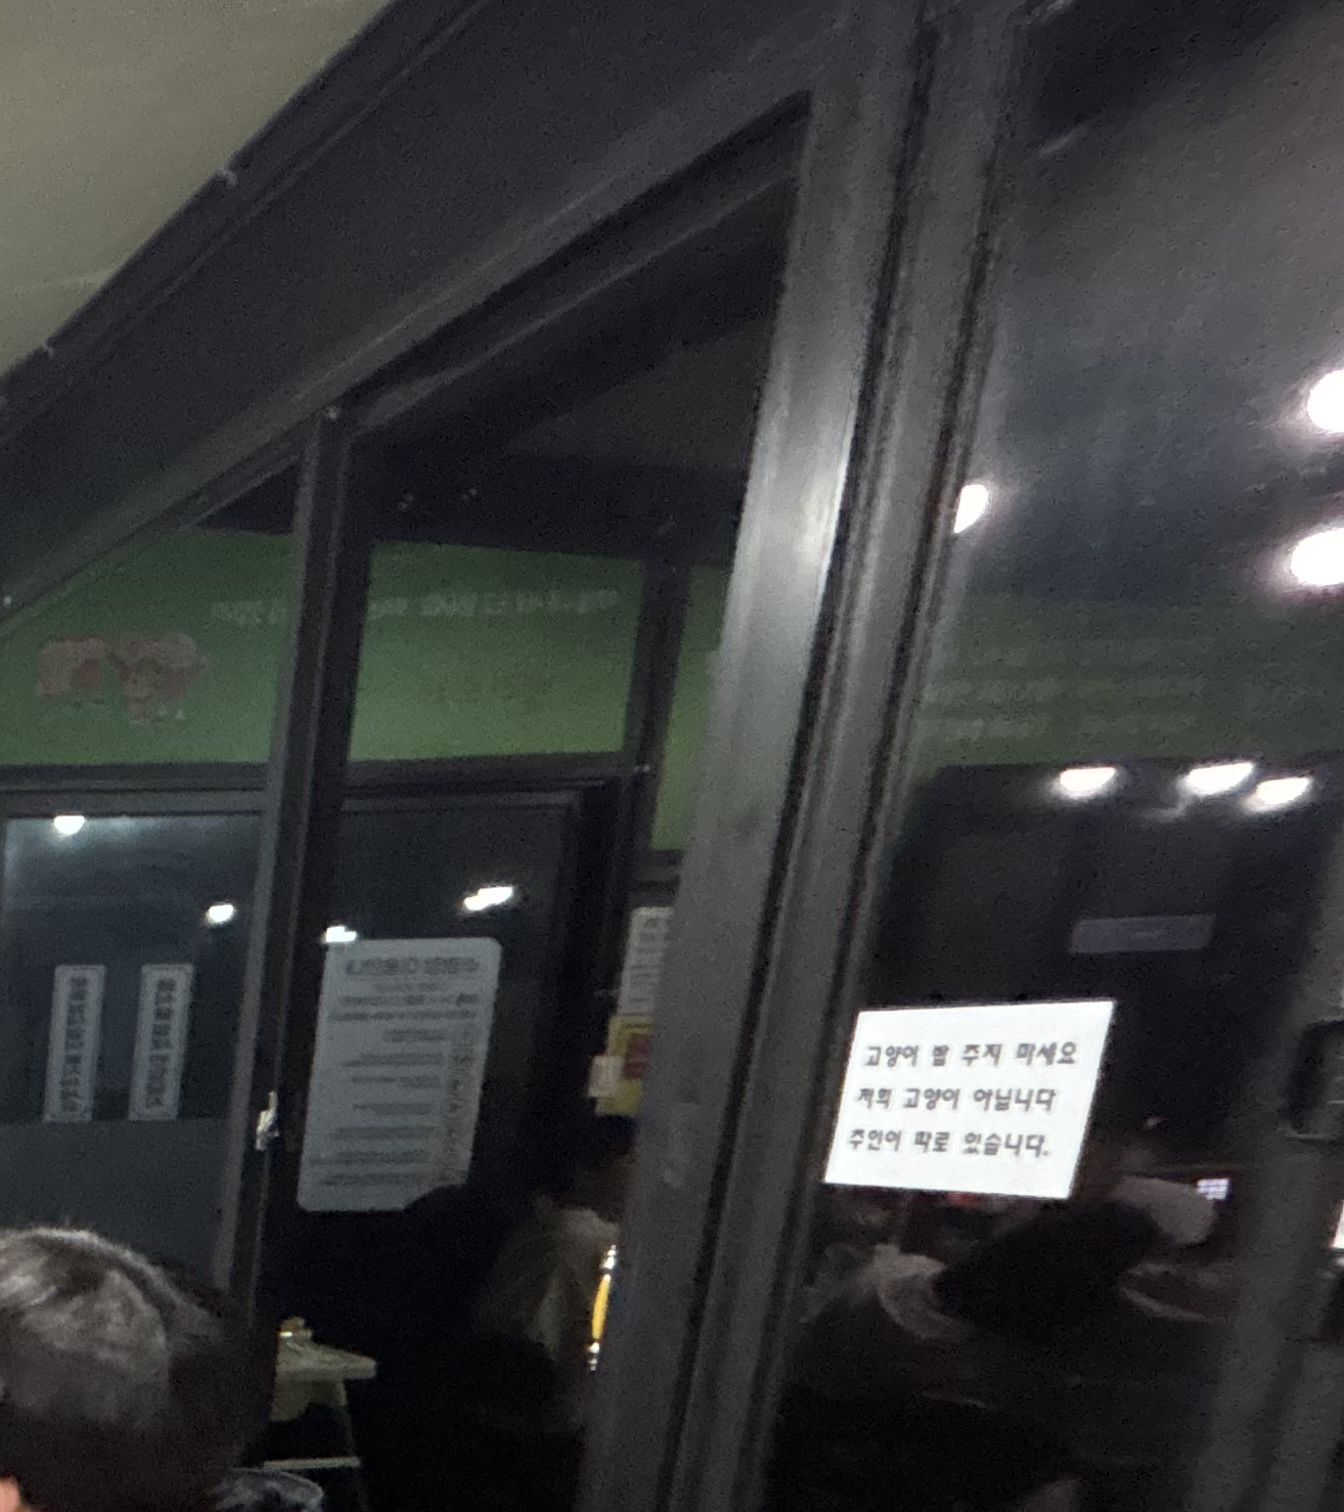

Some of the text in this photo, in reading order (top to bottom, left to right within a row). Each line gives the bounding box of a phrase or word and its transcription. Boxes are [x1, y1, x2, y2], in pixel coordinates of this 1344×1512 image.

[864, 1041, 1078, 1067] 고양이 밥 주지 마세요
[857, 1087, 1057, 1112] 저희 고양이 아닙니다
[847, 1129, 1050, 1158] 주인이 따로 있습니다.
